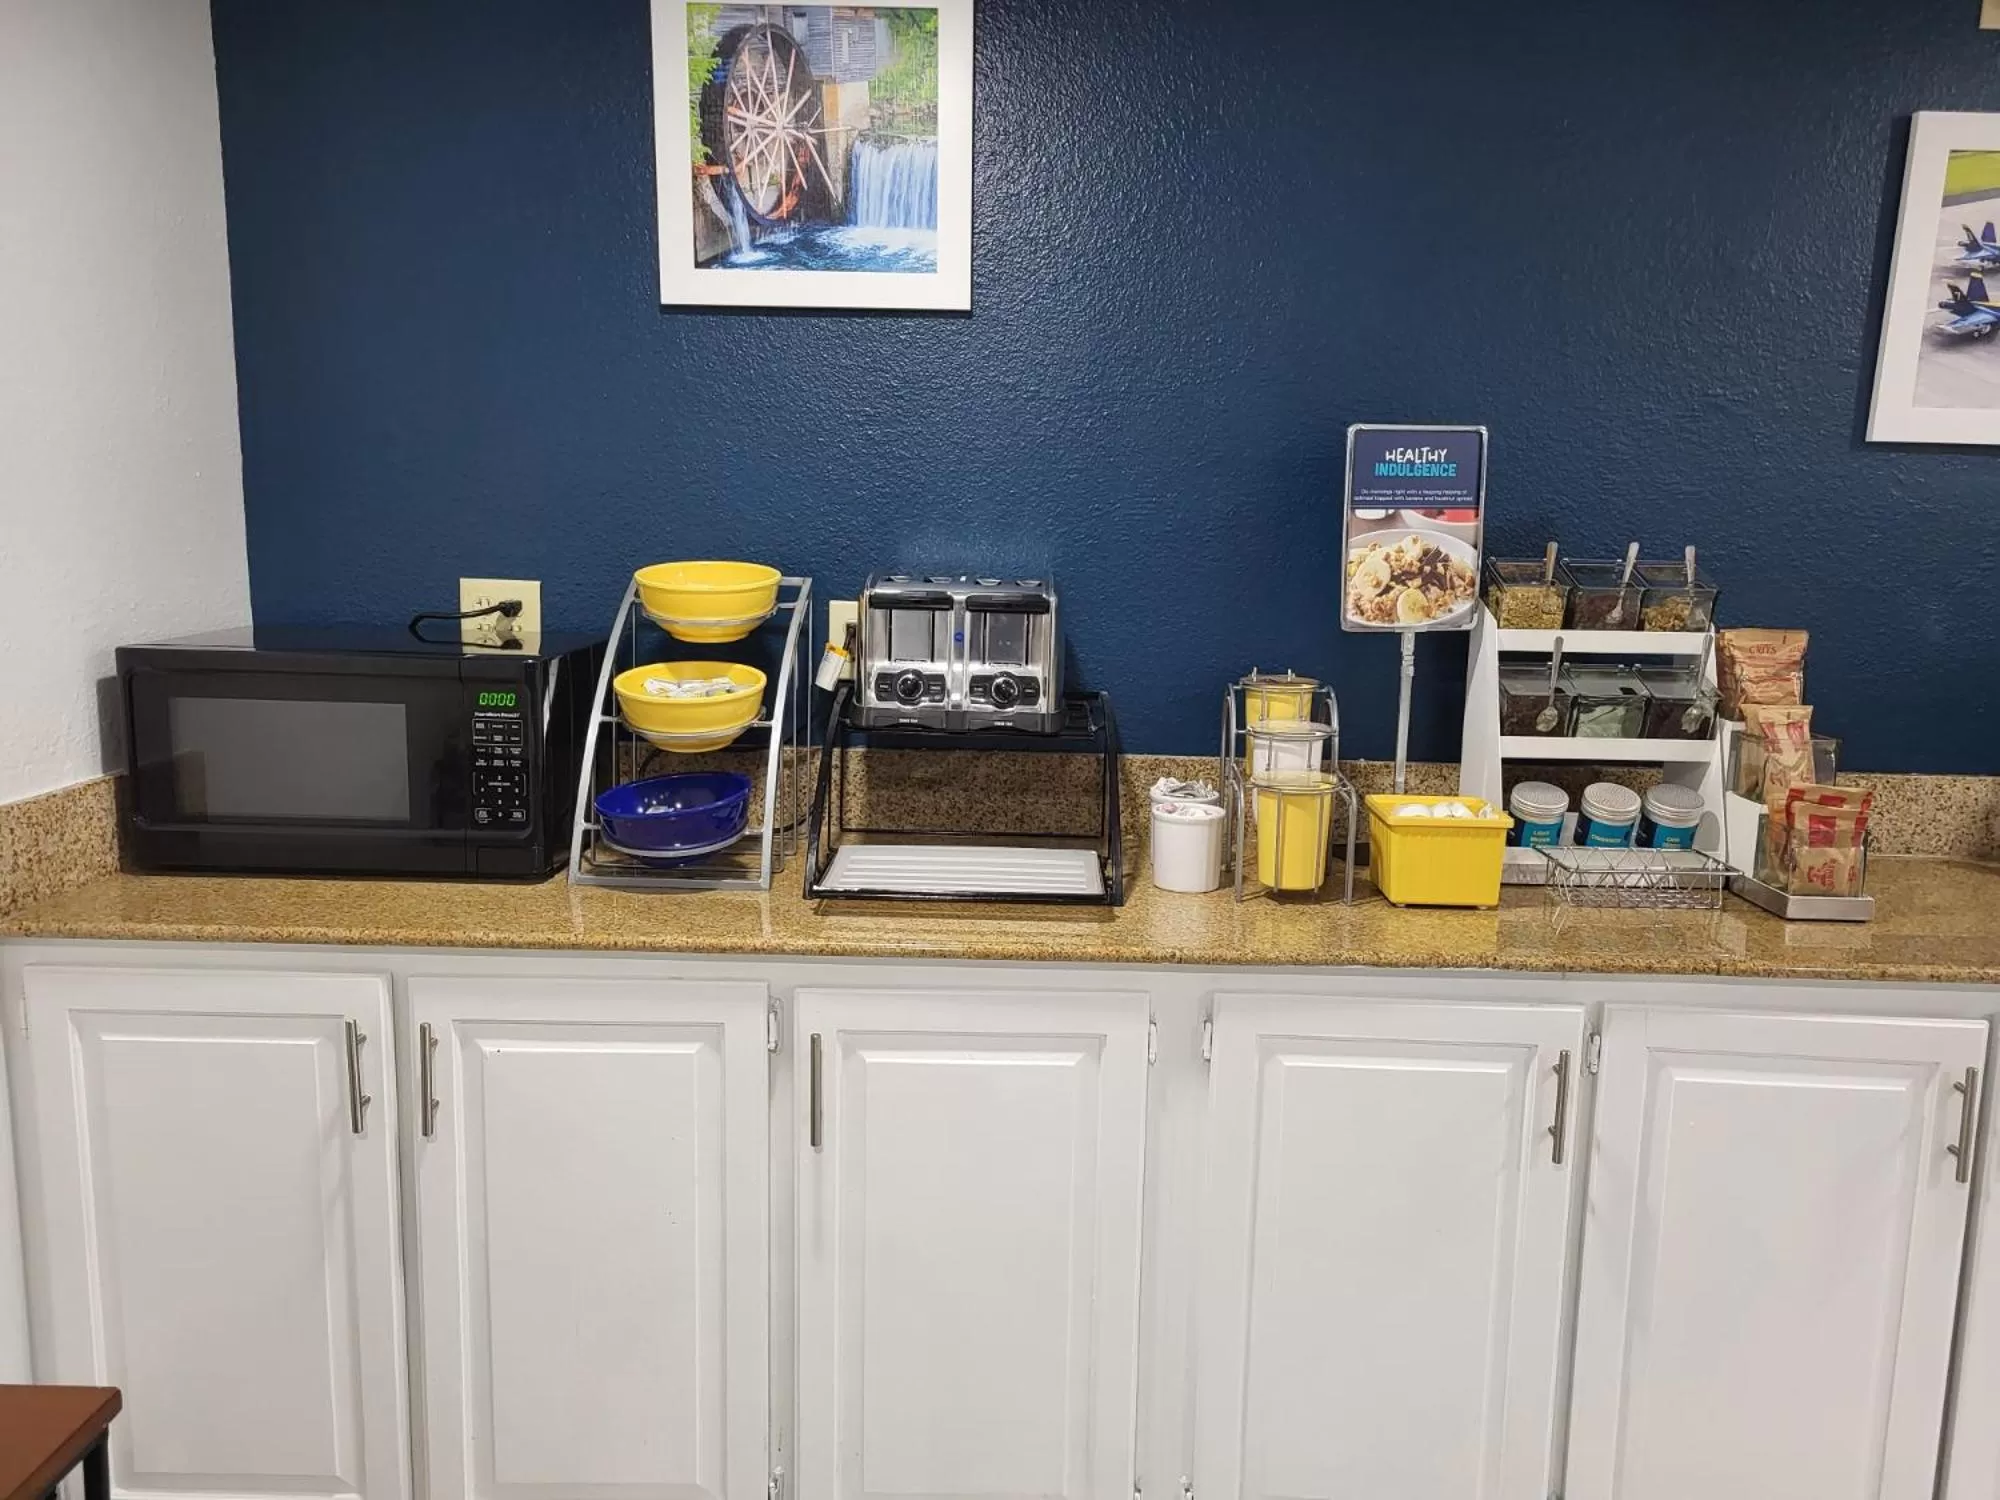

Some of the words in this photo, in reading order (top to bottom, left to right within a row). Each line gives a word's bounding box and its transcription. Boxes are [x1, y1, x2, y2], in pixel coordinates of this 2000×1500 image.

[1385, 446, 1448, 463] HEALTHY
[1374, 462, 1457, 477] INDULGENCE
[480, 692, 516, 706] 0000
